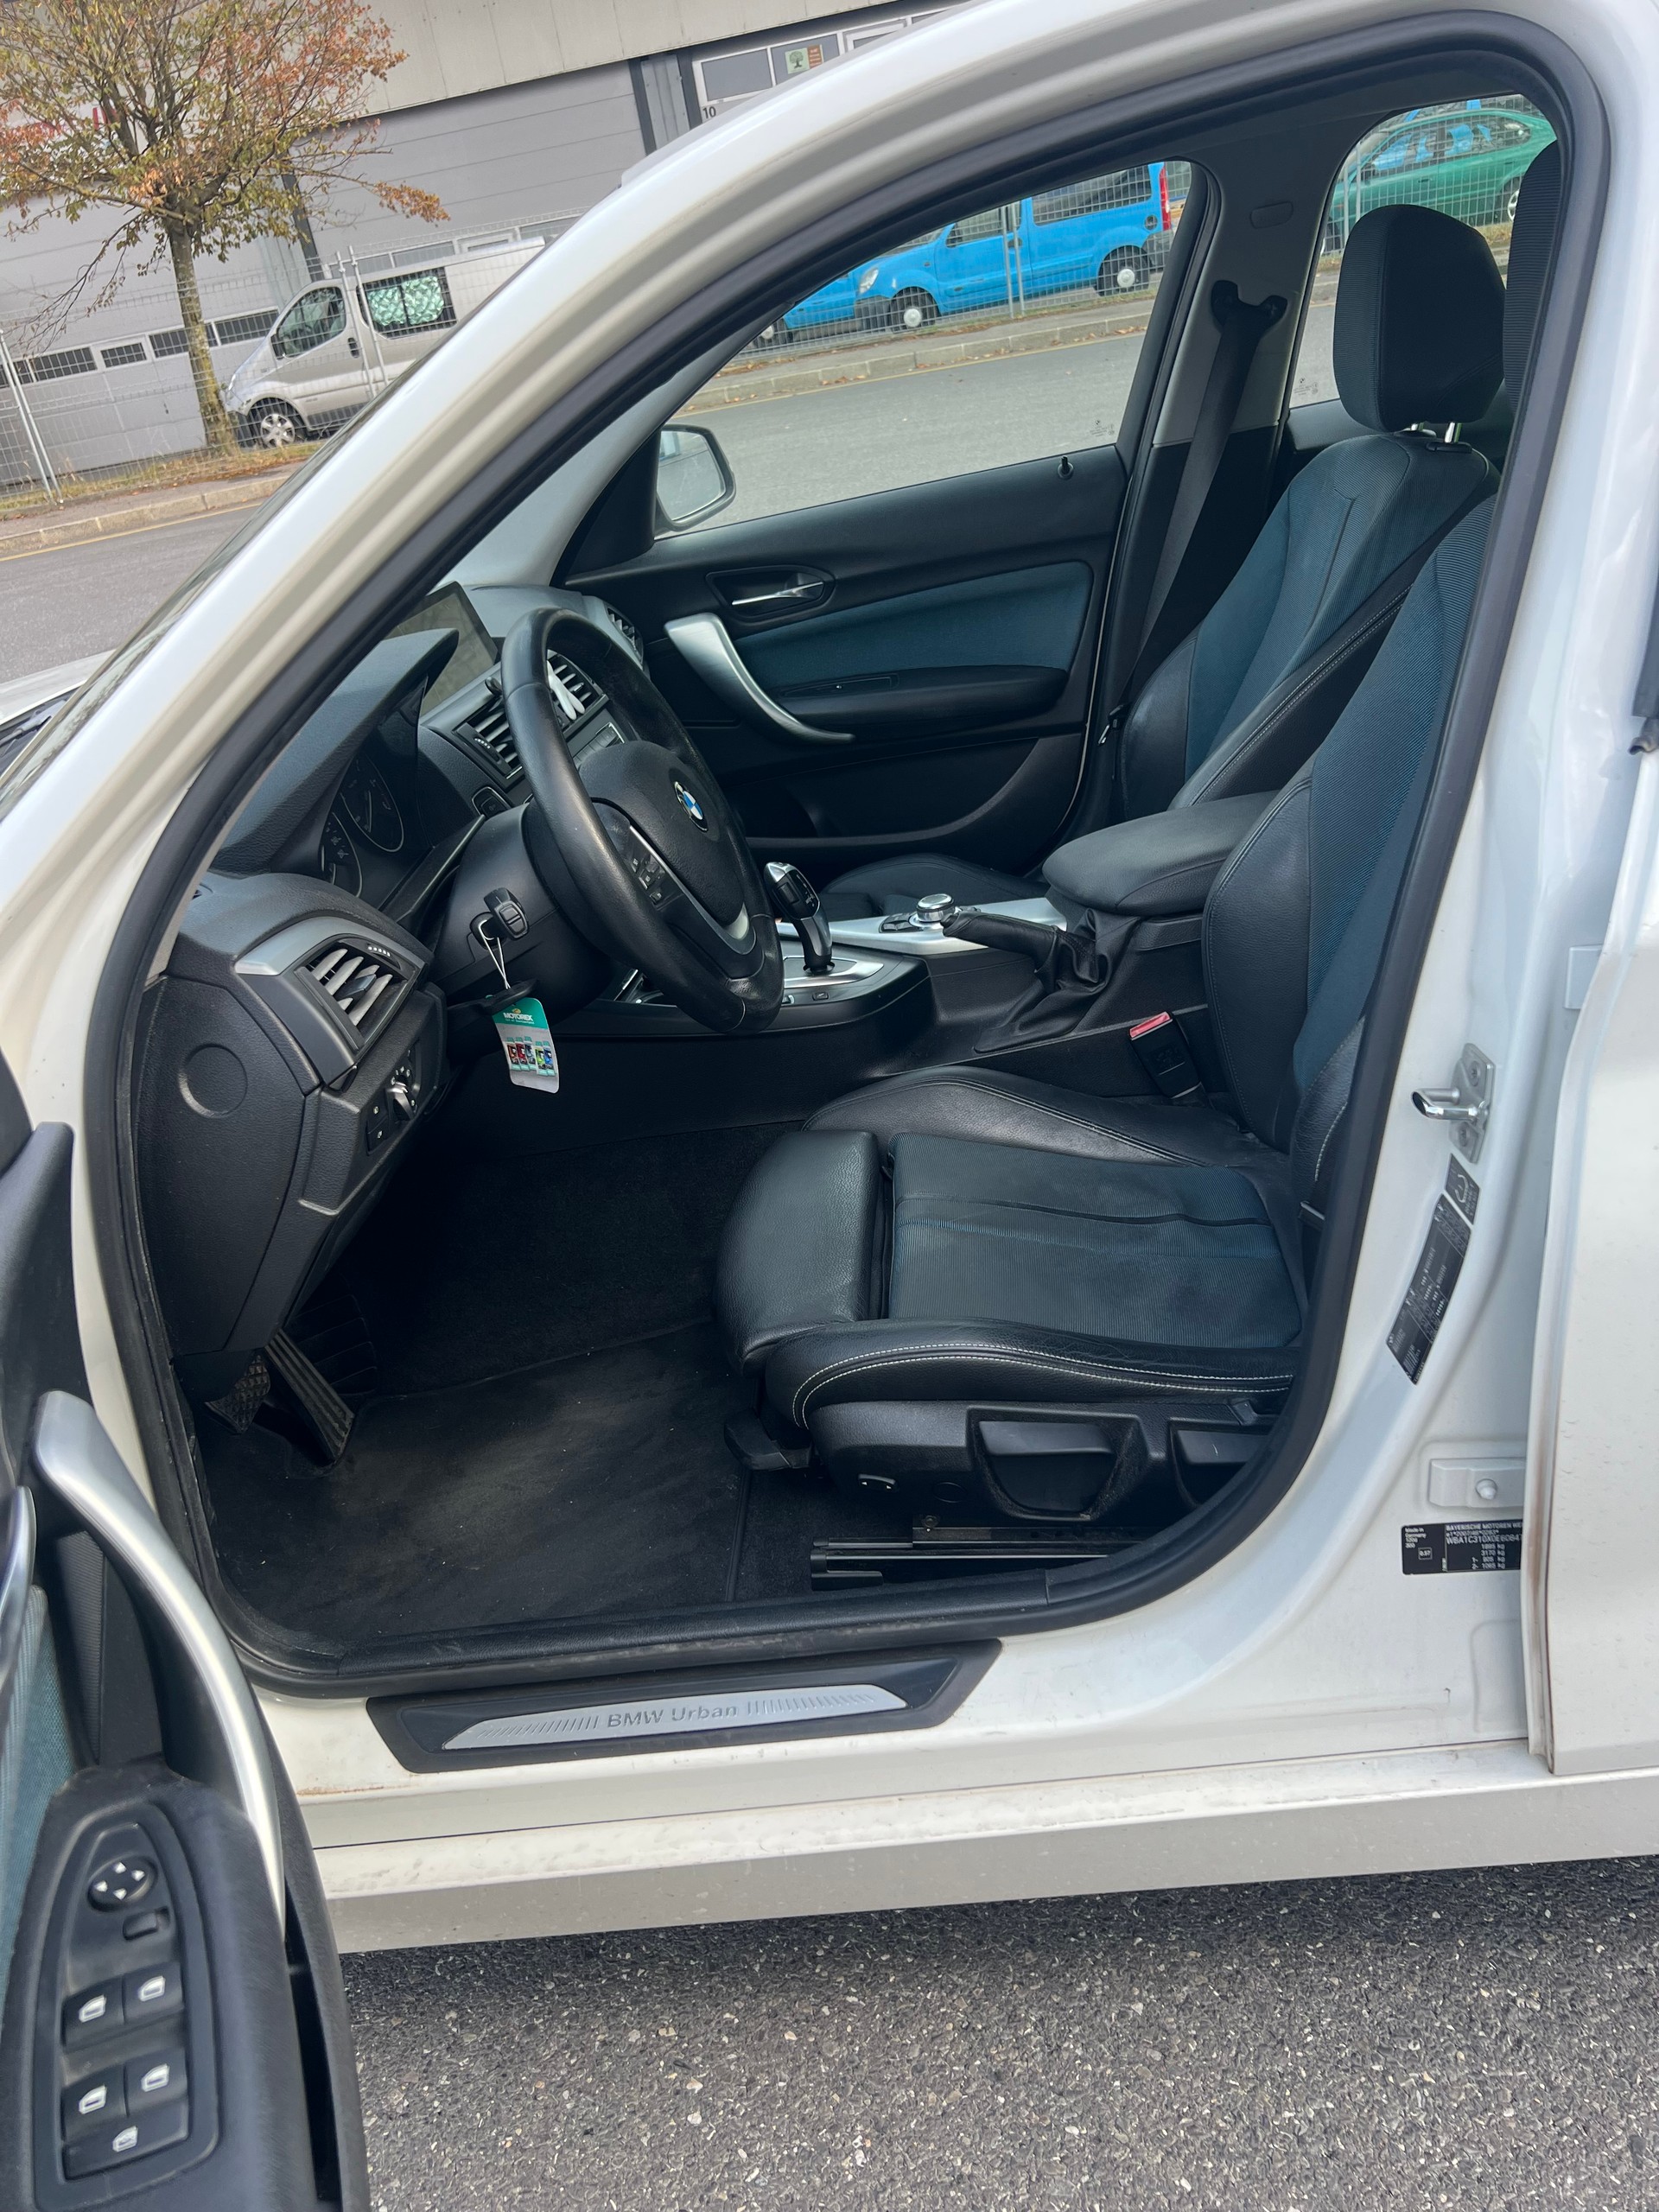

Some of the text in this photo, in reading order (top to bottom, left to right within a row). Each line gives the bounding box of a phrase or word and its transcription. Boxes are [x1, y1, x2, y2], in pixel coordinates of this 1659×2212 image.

[702, 106, 716, 119] 10
[503, 1013, 533, 1021] MOTOREX
[607, 1706, 737, 1728] BMW Urban
